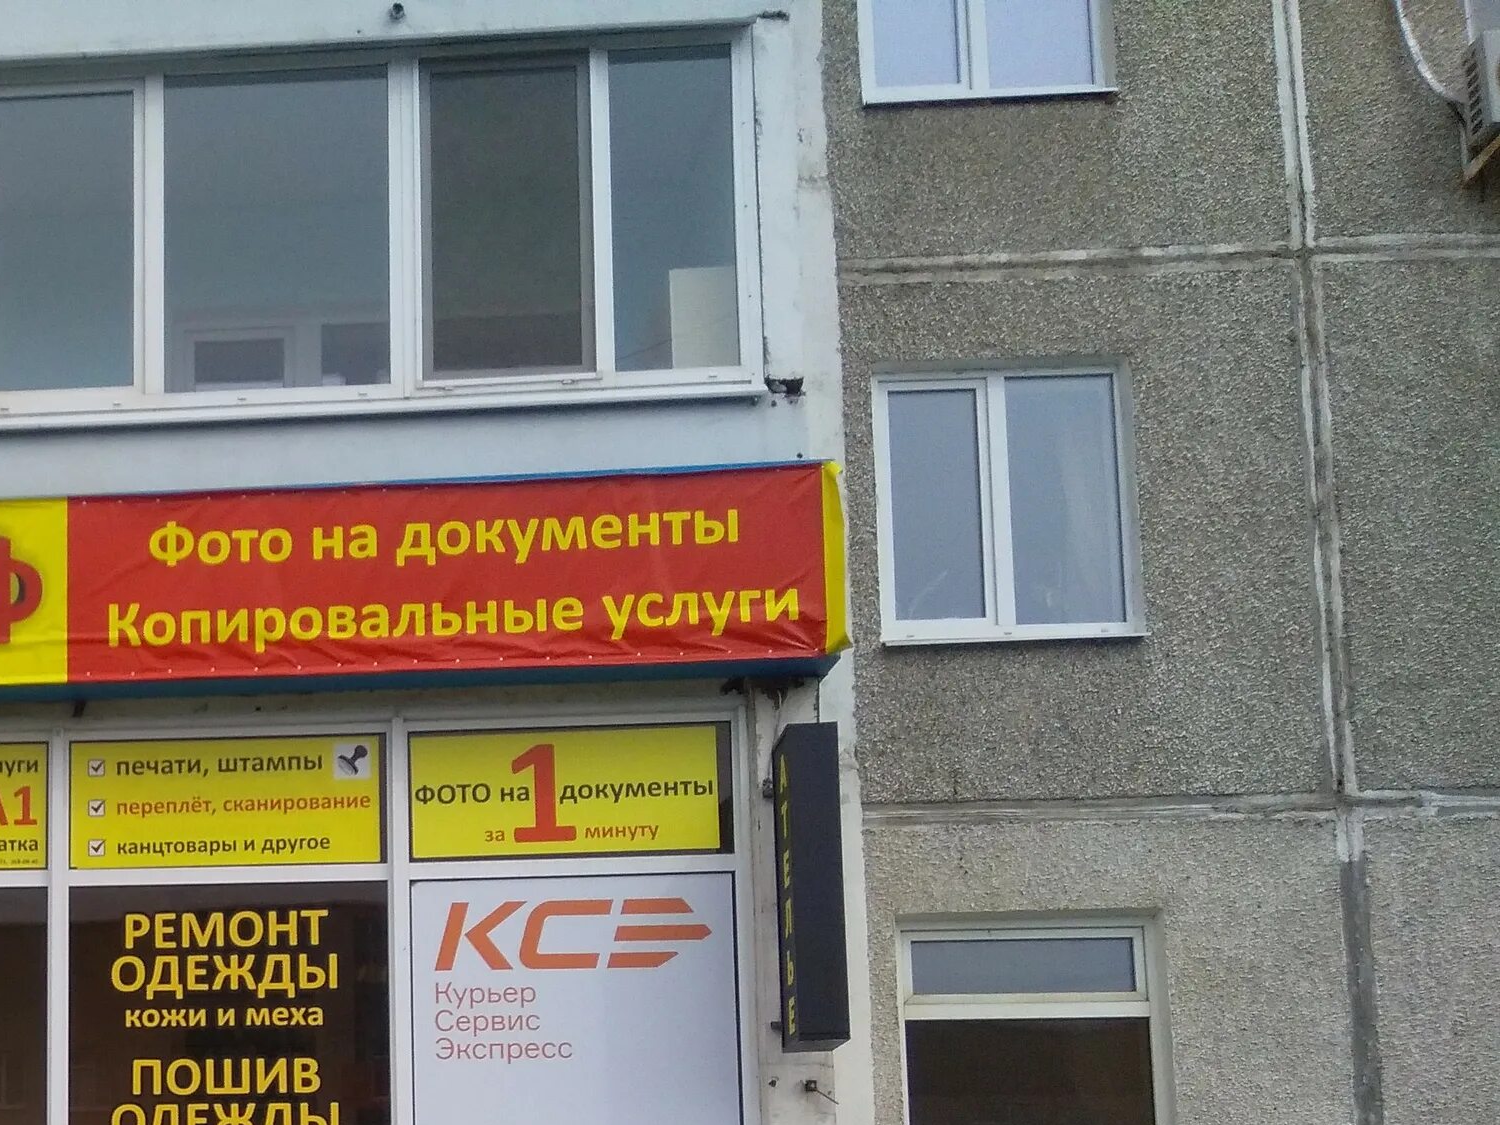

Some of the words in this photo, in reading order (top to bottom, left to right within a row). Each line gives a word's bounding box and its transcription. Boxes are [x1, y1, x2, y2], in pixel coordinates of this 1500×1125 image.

[148, 520, 294, 566] Фото
[312, 523, 379, 560] на
[396, 509, 741, 565] документы
[108, 593, 585, 654] Копировальные
[602, 586, 801, 638] услуги
[116, 756, 210, 778] печати,
[217, 753, 323, 773] штампы
[414, 782, 491, 805] ФОТО
[499, 785, 530, 803] на
[559, 778, 714, 803] документы
[483, 828, 505, 843] за
[511, 743, 578, 843] 1
[584, 823, 660, 841] минуту
[116, 796, 217, 818] переплёт,
[223, 794, 371, 814] сканирование
[116, 837, 238, 857] канцтовары
[242, 837, 256, 852] и
[261, 835, 331, 857] другое
[124, 909, 329, 949] РЕМОНТ
[111, 953, 339, 1000] ОДЕЖДЫ
[435, 981, 537, 1009] Курьер
[124, 1007, 207, 1028] кожи
[217, 1007, 236, 1027] и
[245, 1005, 324, 1027] меха
[434, 1009, 541, 1037] Сервис
[435, 1037, 574, 1064] Экспресс
[131, 1057, 322, 1096] ПОШИВ
